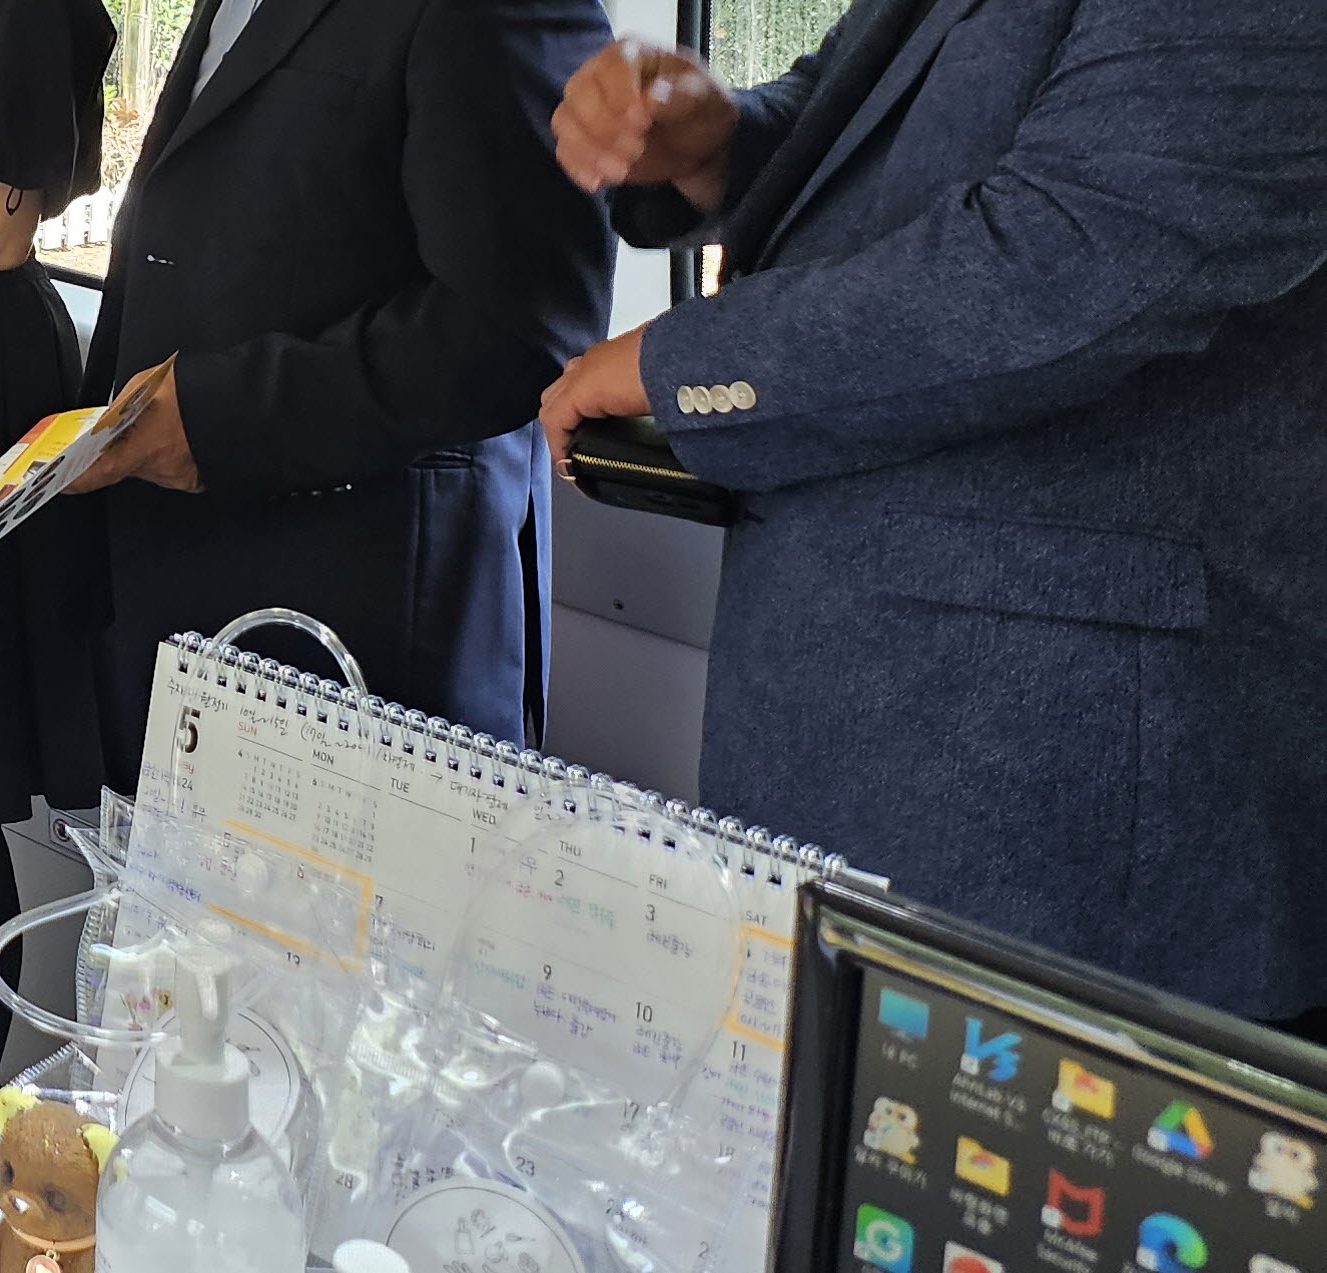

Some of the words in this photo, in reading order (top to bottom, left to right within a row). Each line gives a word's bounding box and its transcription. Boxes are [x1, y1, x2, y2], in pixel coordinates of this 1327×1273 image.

[178, 705, 201, 754] 5
[238, 721, 258, 737] SUN
[312, 749, 334, 766] MON
[391, 777, 410, 794] TUE
[472, 808, 496, 826] WED
[560, 840, 582, 857] THU
[649, 874, 667, 890] FRI
[744, 911, 767, 927] SAT
[554, 869, 565, 886] 2
[645, 904, 656, 922] 3
[543, 964, 552, 980] 9
[635, 1001, 653, 1023] 10
[732, 1040, 746, 1061] 11
[623, 1101, 639, 1120] 17
[515, 1156, 535, 1177] 23
